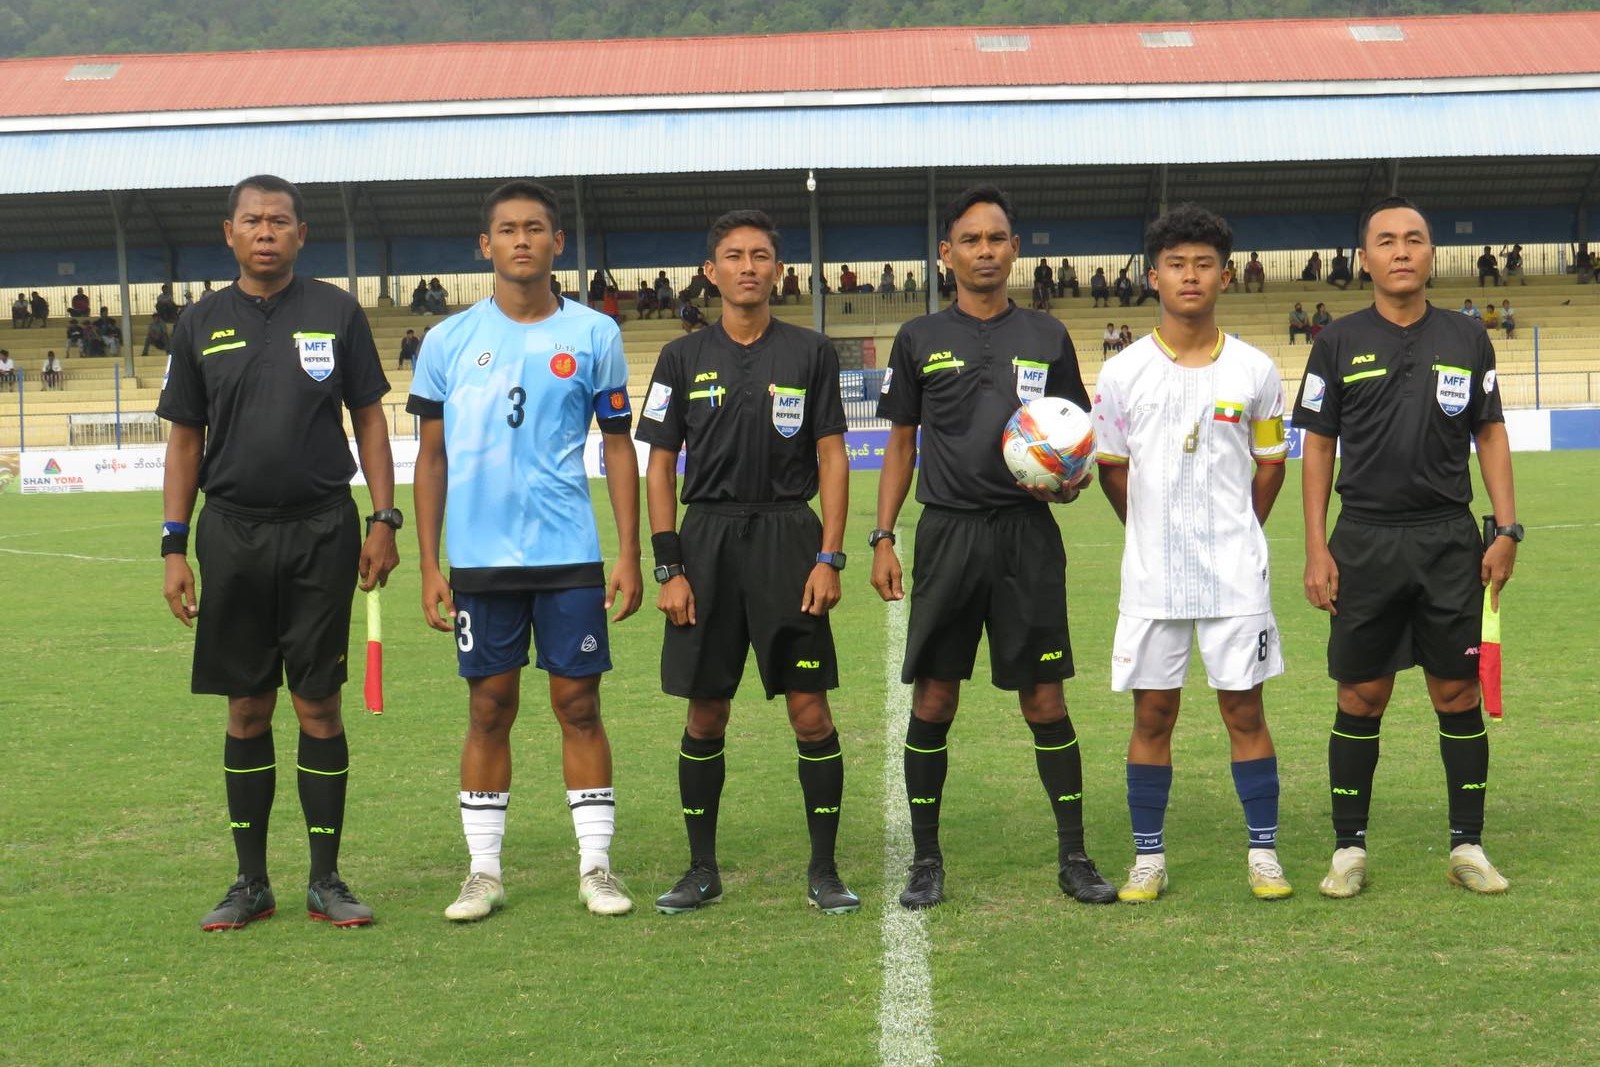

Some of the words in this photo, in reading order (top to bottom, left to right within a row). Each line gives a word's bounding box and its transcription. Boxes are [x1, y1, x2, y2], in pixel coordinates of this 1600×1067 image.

[304, 341, 328, 351] MFF
[1023, 369, 1045, 382] MFF
[1443, 374, 1467, 387] MFF
[1020, 385, 1044, 394] REFEREE
[1440, 389, 1467, 400] REFEREE
[779, 396, 802, 407] MFF
[507, 386, 527, 429] 3
[775, 411, 801, 420] REFEREE
[23, 477, 51, 486] SHAN
[54, 476, 84, 485] YOMA
[457, 610, 475, 653] 3
[1257, 629, 1268, 662] 8
